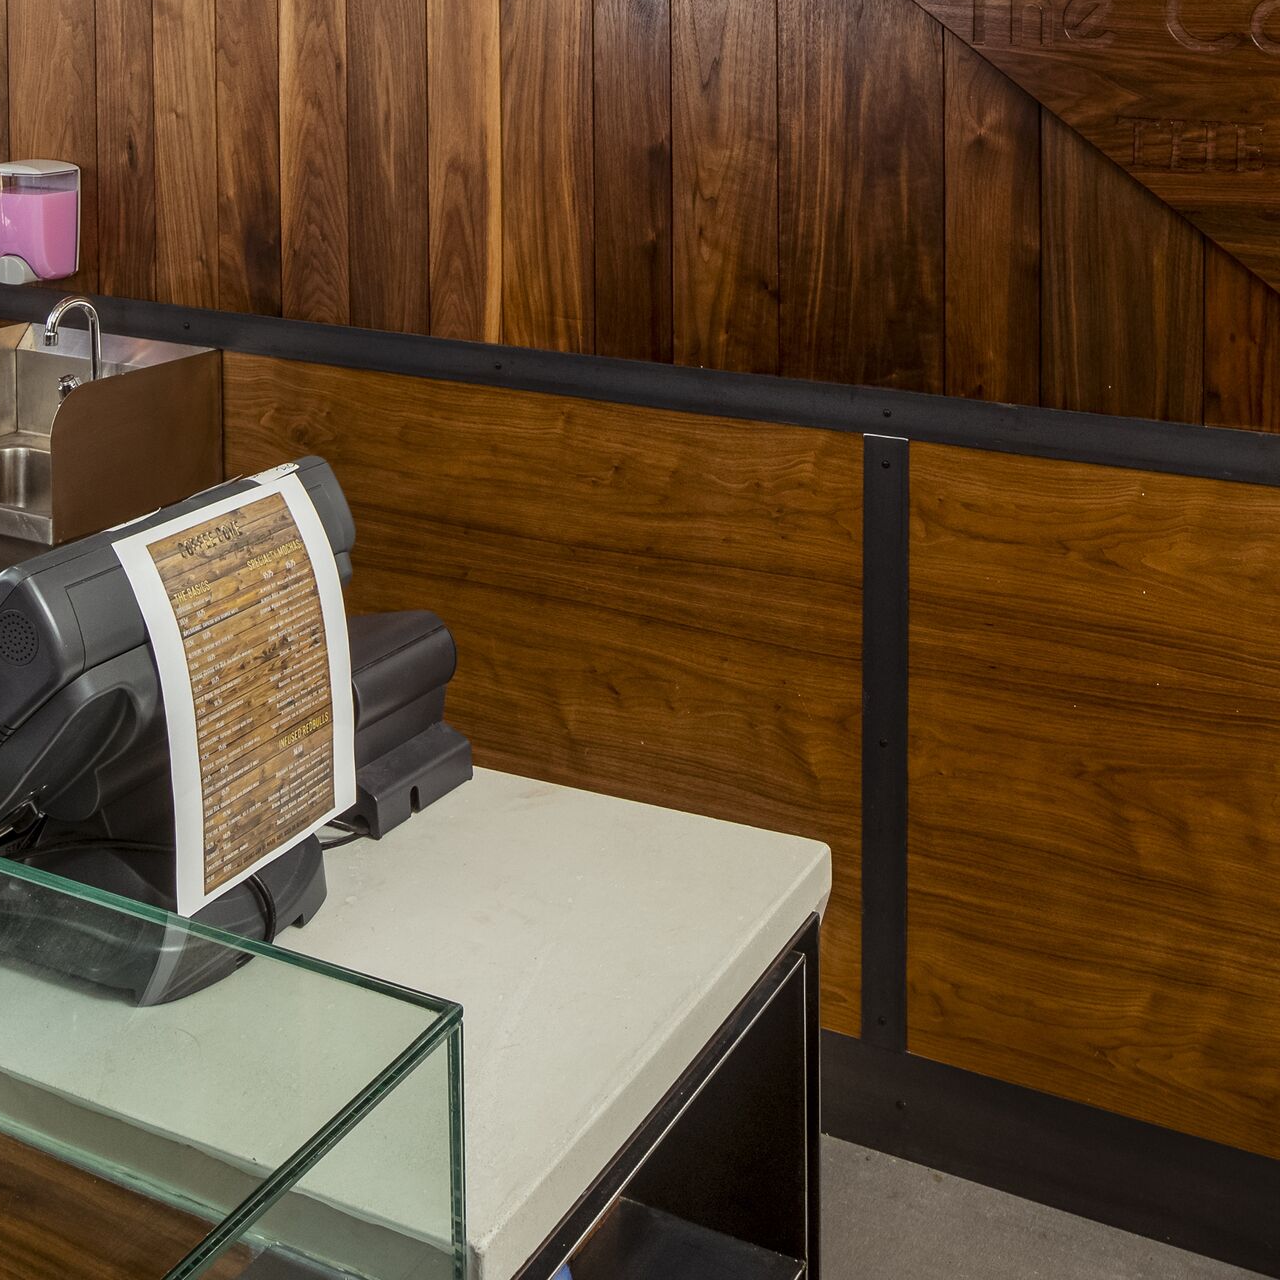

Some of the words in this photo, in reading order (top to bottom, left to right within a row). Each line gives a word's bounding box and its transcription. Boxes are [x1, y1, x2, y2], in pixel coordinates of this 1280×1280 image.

[1127, 120, 1266, 173] THE
[173, 590, 187, 604] THE
[187, 580, 212, 599] BASICS
[279, 730, 302, 749] INFUSED
[302, 711, 329, 736] REDBULLS
